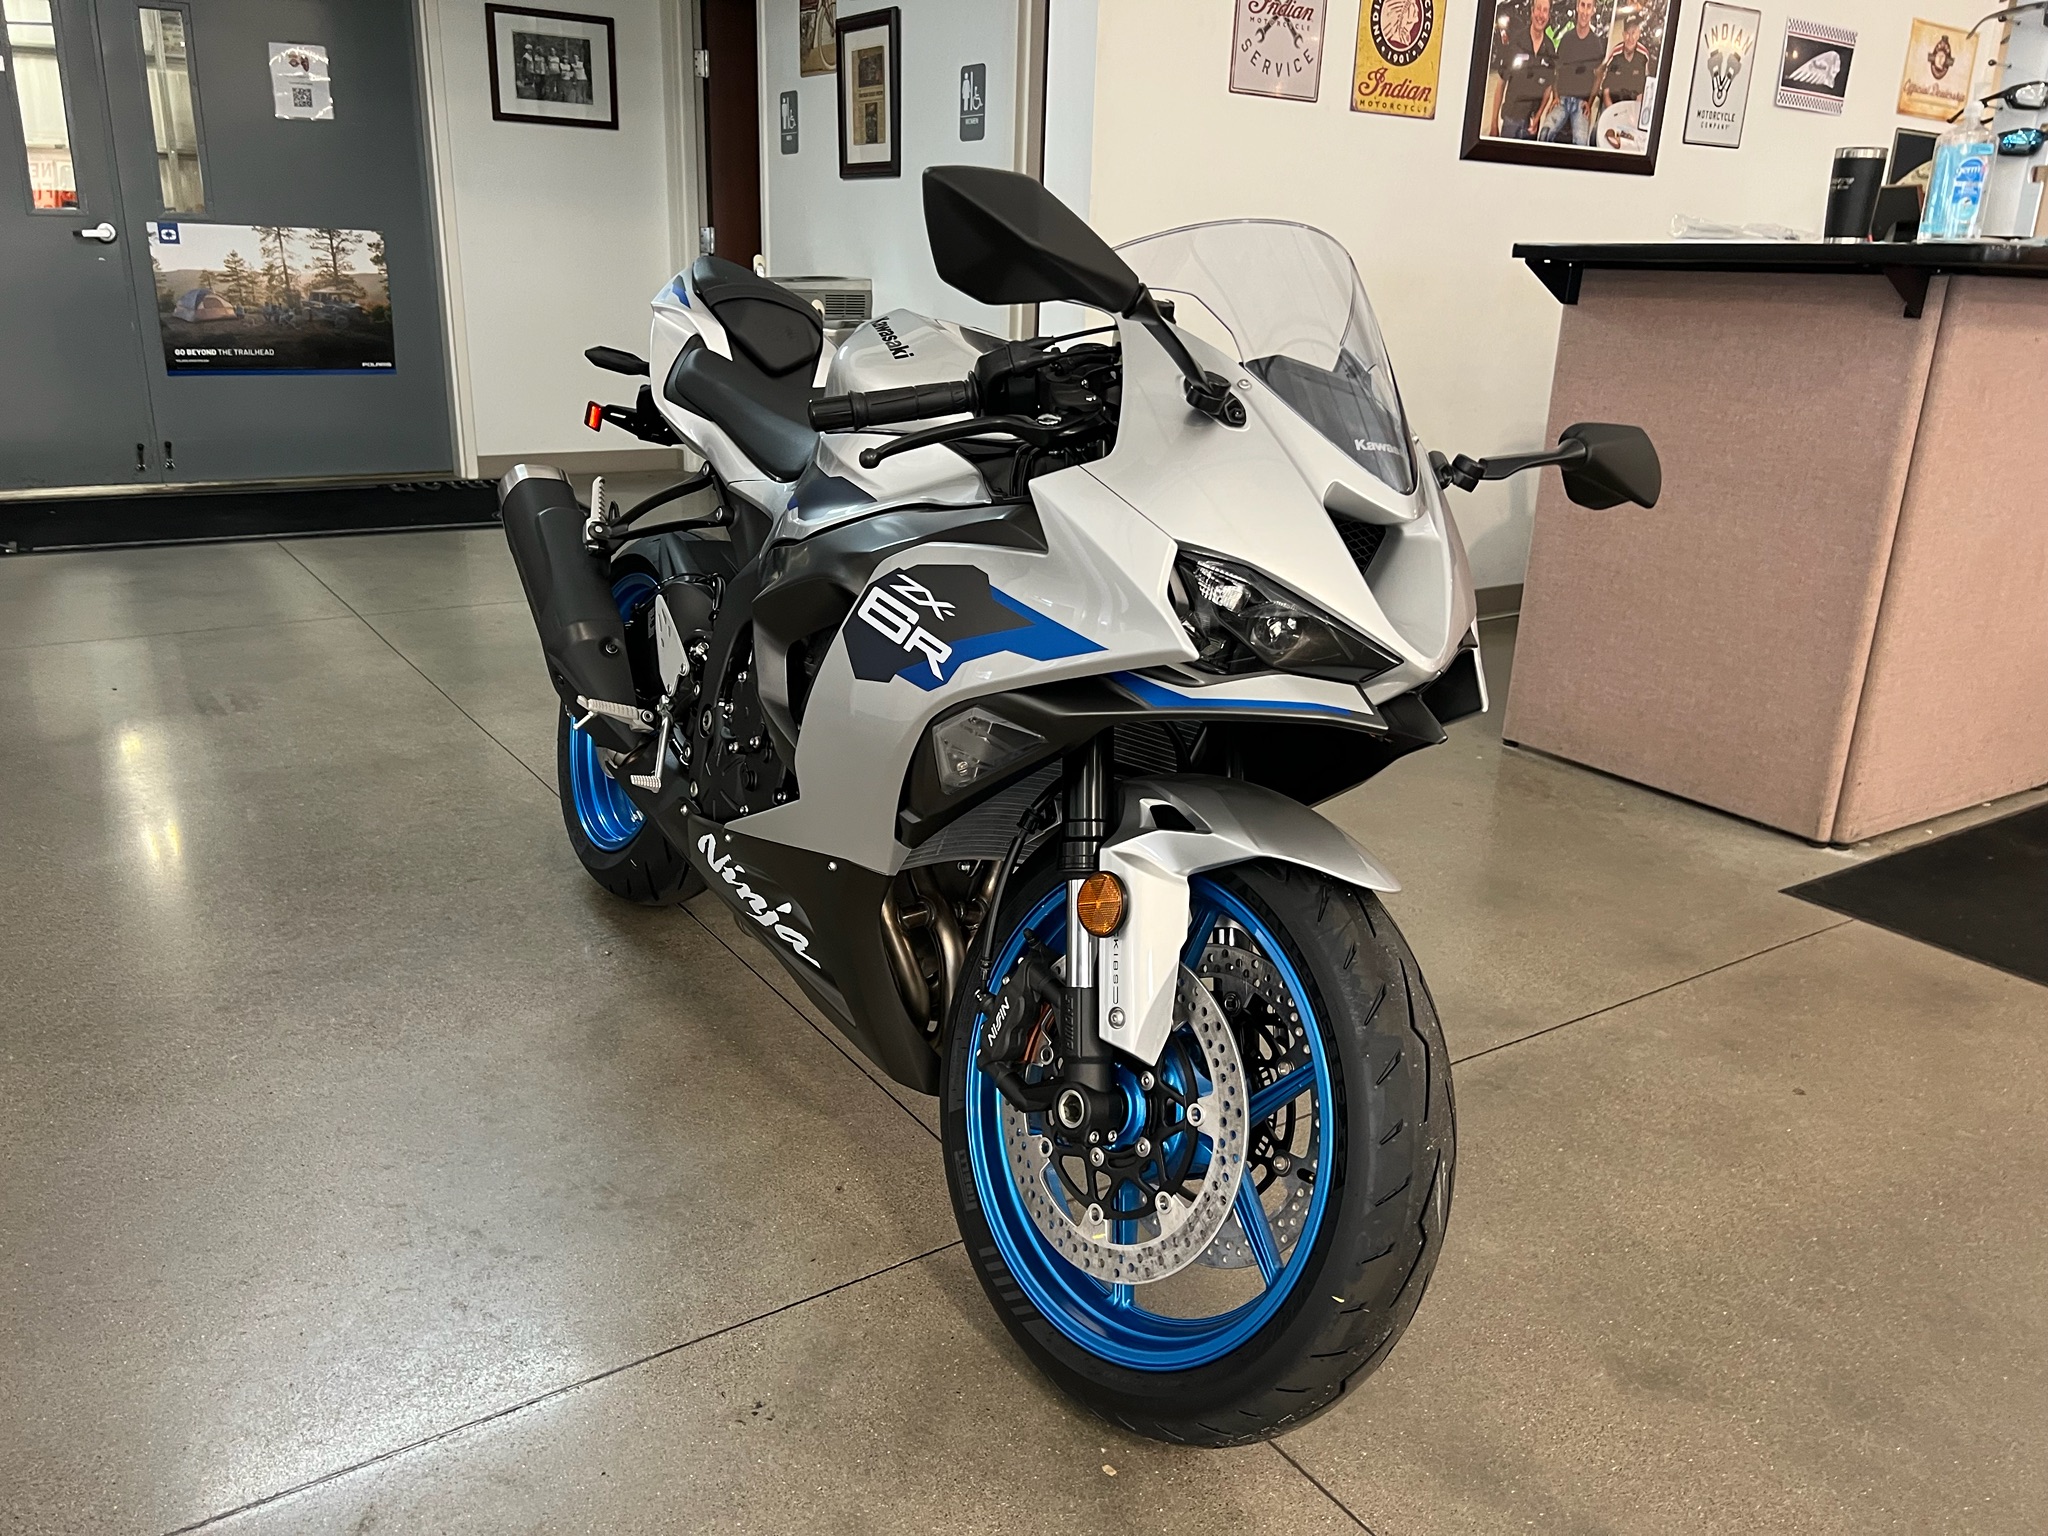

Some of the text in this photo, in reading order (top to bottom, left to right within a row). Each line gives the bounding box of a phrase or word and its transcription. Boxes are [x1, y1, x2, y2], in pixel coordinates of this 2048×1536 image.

[1704, 23, 1753, 55] INDIAN
[1241, 38, 1314, 78] SERVICE
[1387, 51, 1410, 64] 1901
[1358, 67, 1432, 102] Indian
[1360, 99, 1428, 113] MOTORCYCLE
[1696, 109, 1736, 123] MOTORCYCLE
[1700, 121, 1730, 130] COMPANY
[870, 315, 915, 360] Kawasaki
[174, 348, 275, 356] GO BEYOND THE TRAILHEAD
[697, 833, 821, 970] Ninja
